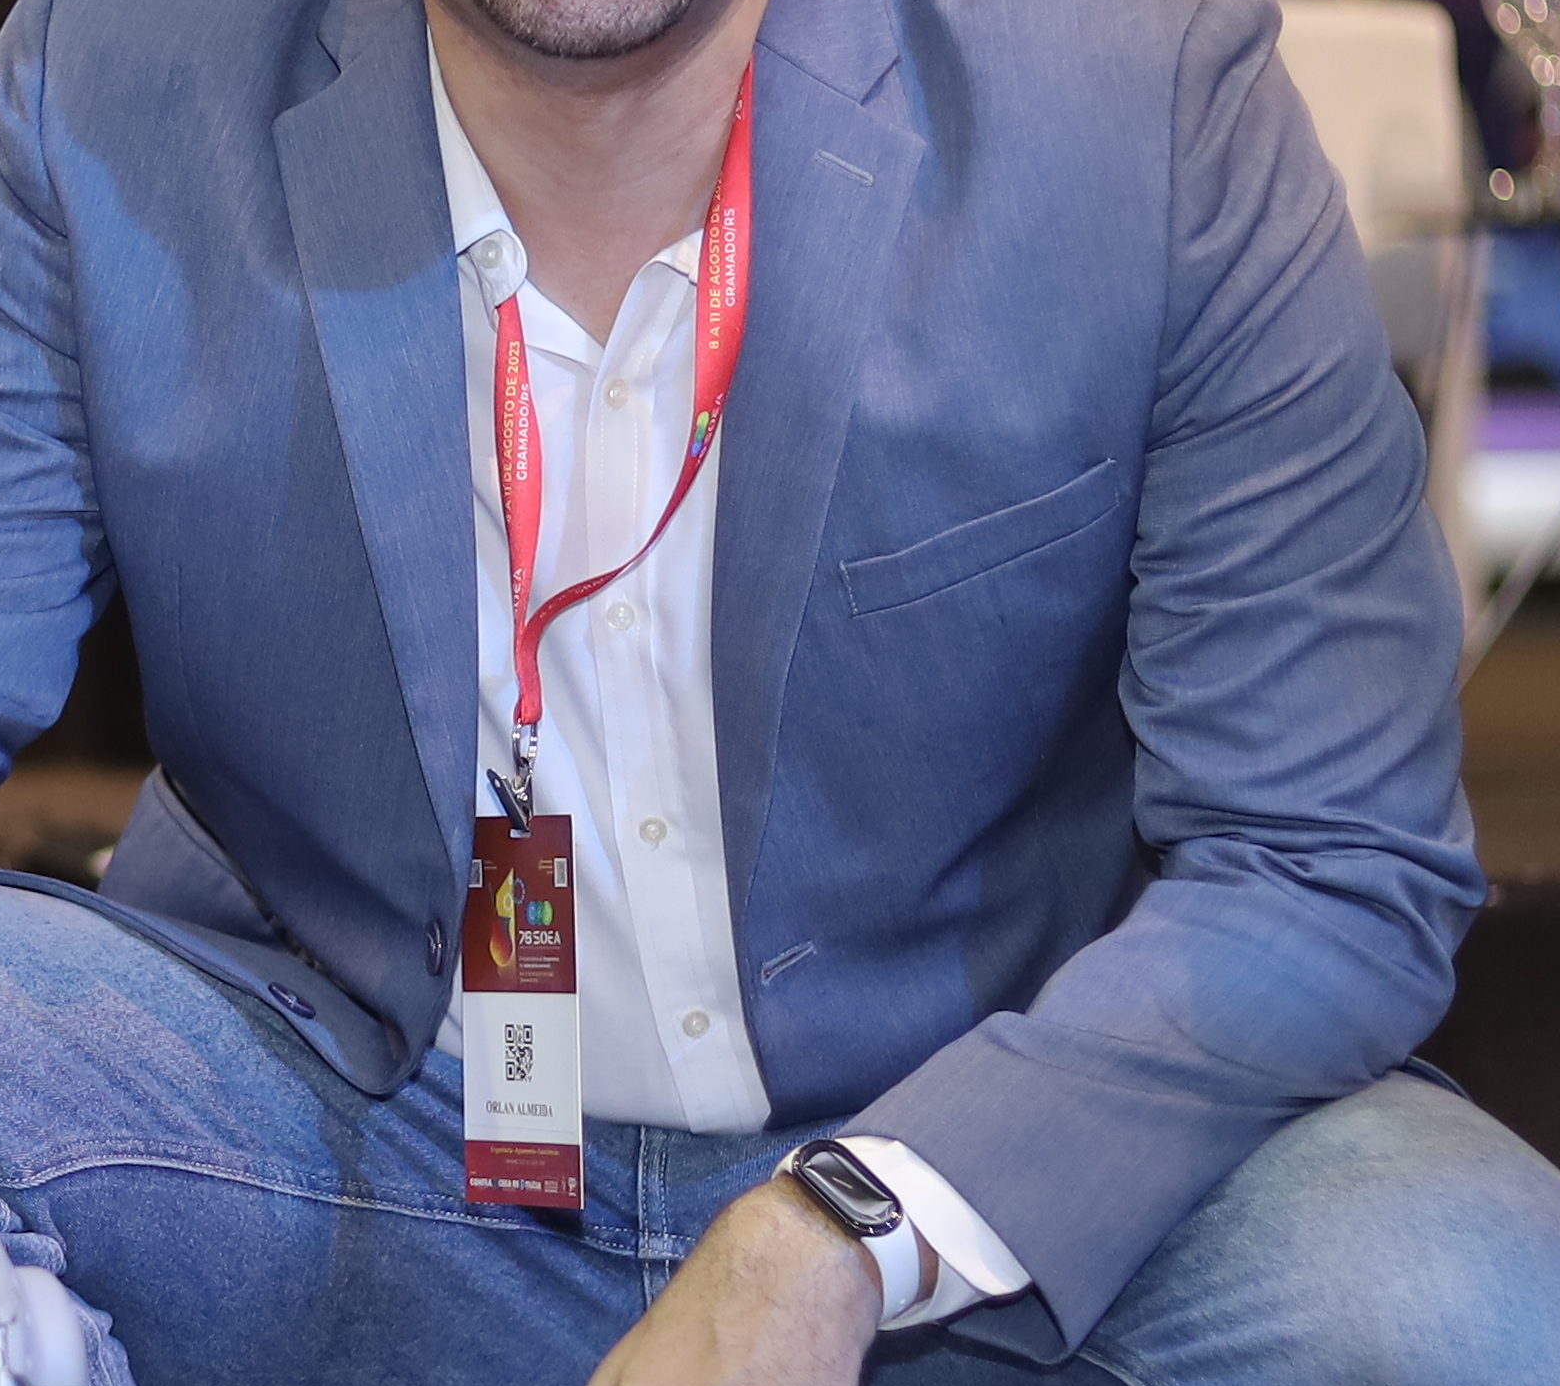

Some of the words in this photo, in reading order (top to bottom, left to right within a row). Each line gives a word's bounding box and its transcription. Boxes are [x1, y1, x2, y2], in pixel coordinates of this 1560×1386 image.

[709, 226, 721, 286] AGOSTO
[723, 208, 737, 308] GRAMADO/RS
[709, 288, 721, 308] DE
[709, 312, 721, 323] 11
[709, 326, 720, 338] A
[709, 340, 719, 350] 8
[507, 340, 521, 374] 2023
[506, 376, 518, 397] DE
[502, 400, 516, 460] AGOSTO
[503, 462, 513, 482] DE
[485, 1100, 515, 1116] ORLAN
[516, 1101, 554, 1118] ALMEIDA
